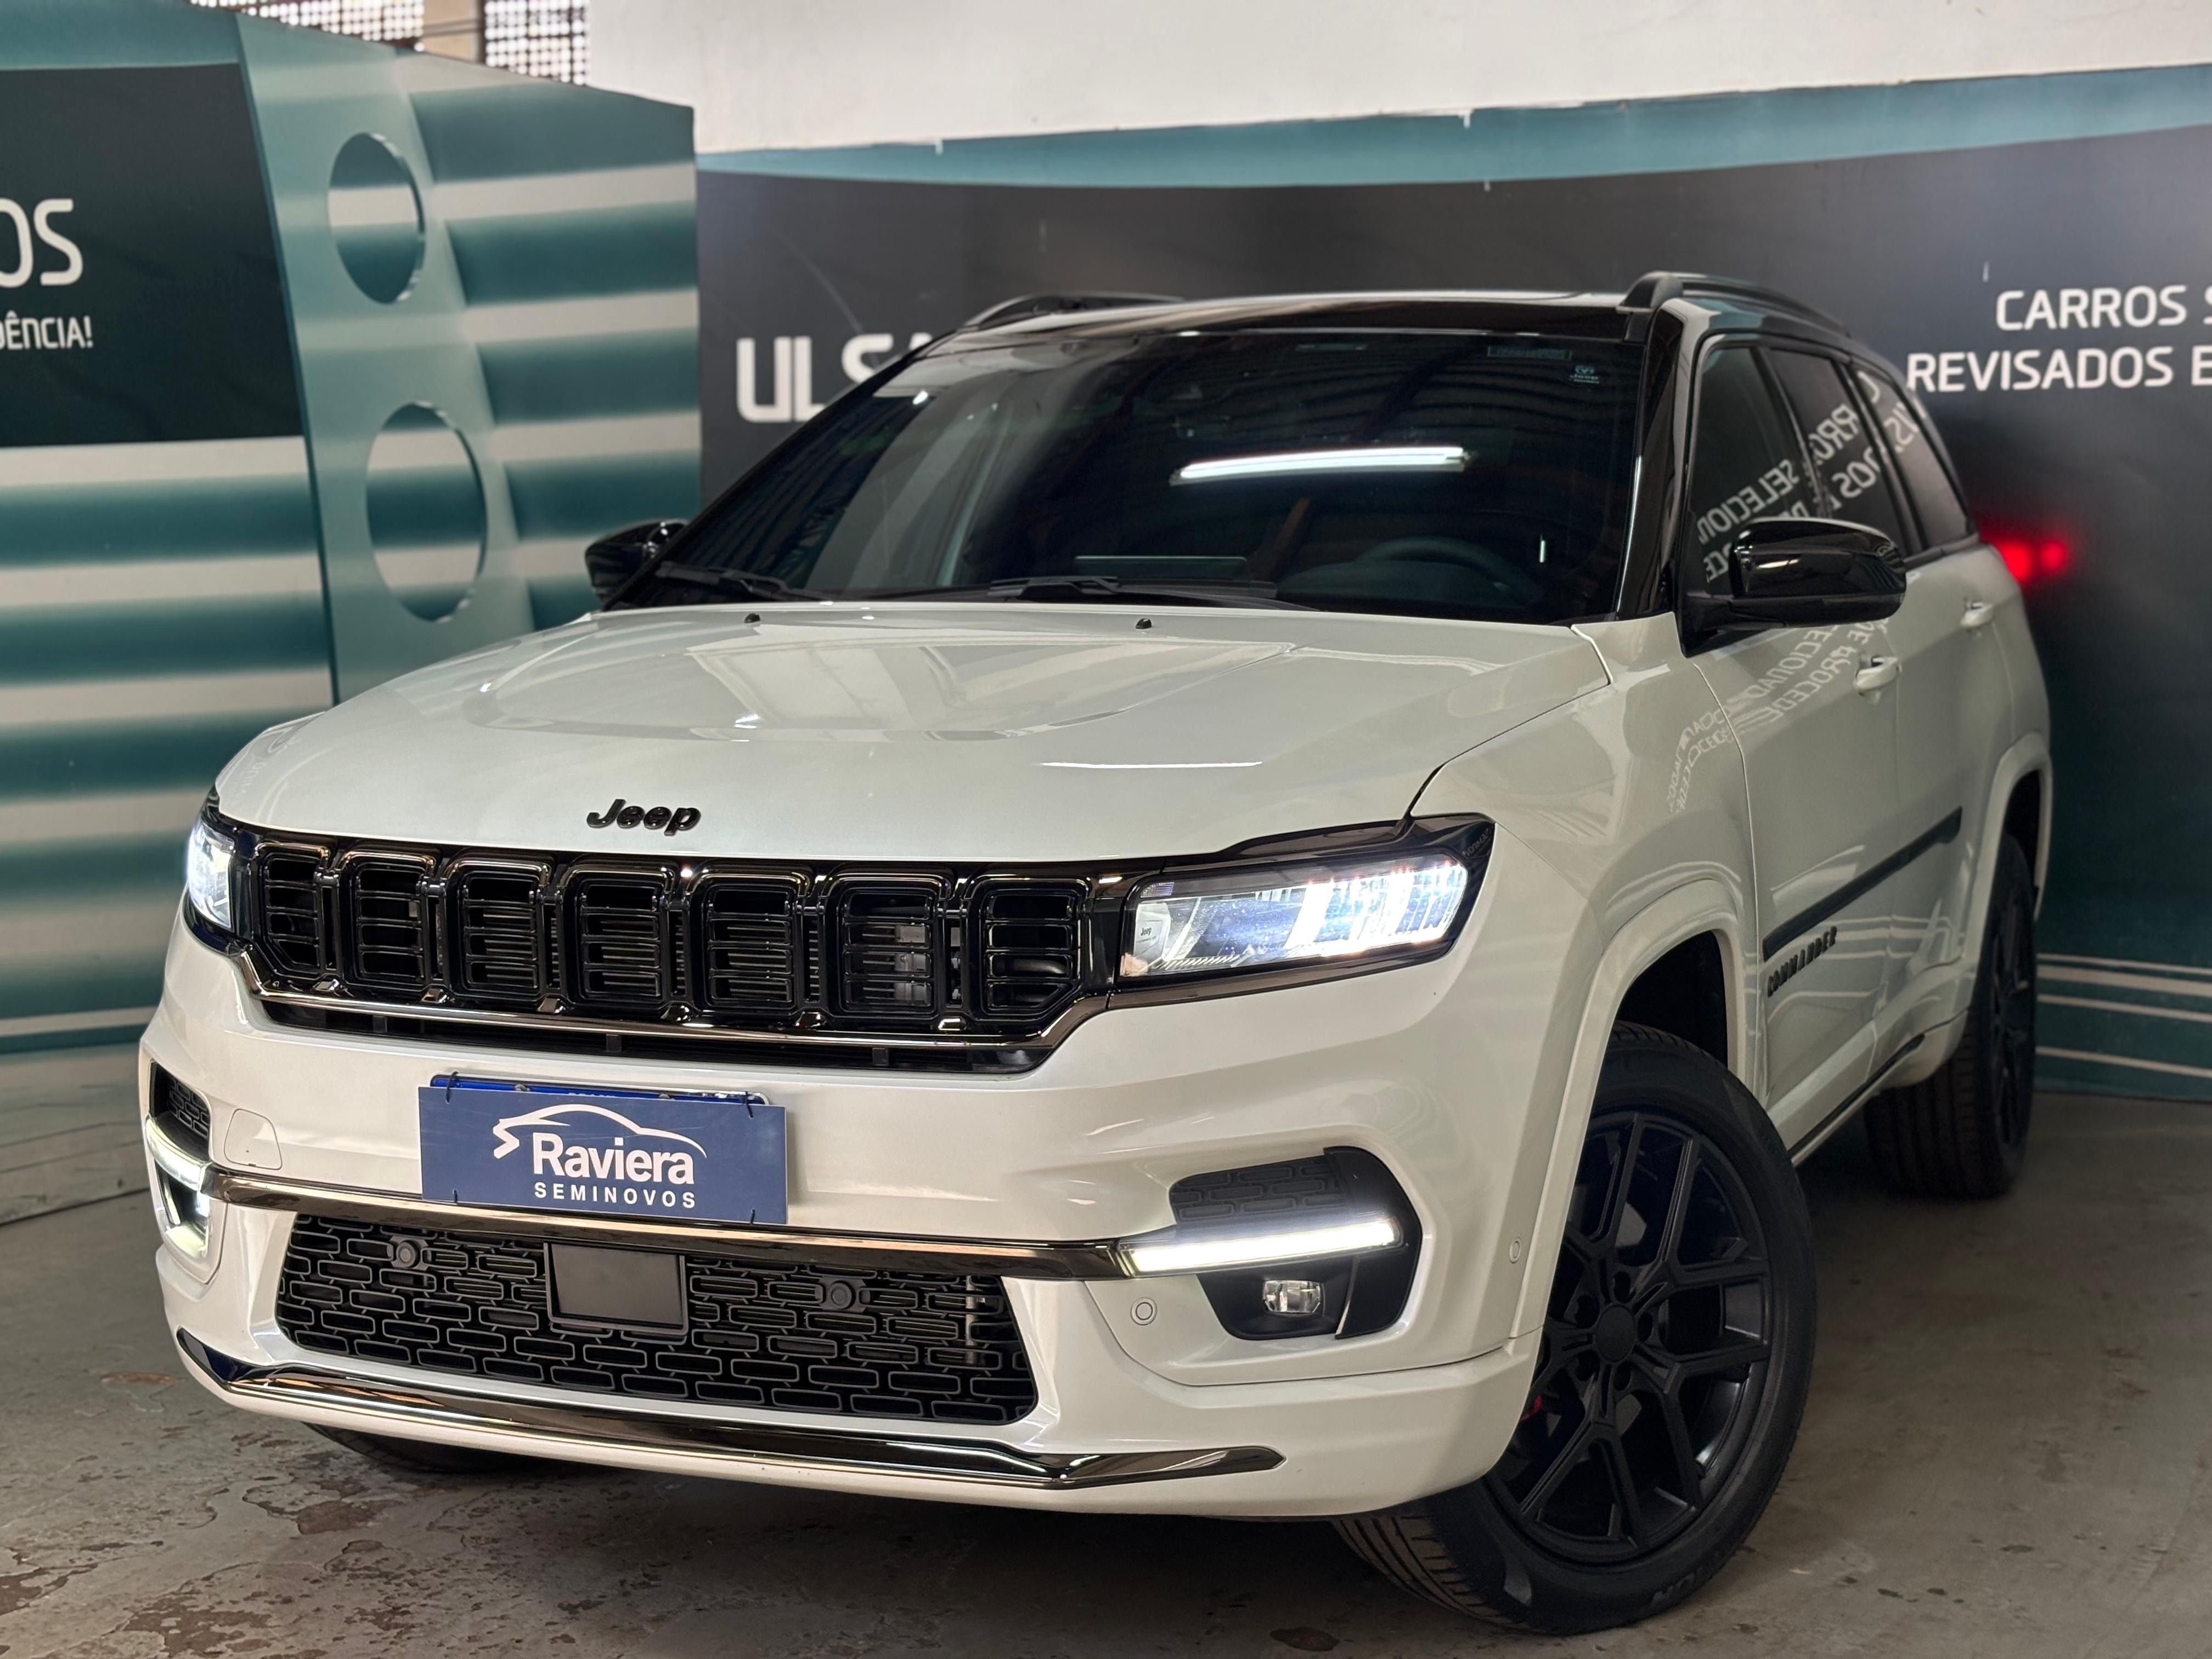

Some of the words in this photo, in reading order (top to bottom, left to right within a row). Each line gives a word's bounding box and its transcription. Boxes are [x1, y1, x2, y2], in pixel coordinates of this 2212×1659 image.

[1996, 285, 2187, 330] CARROS
[1906, 346, 2174, 392] REVISADOS
[586, 799, 701, 836] Jeep
[533, 1132, 695, 1184] Raviera
[534, 1182, 696, 1209] SEMINOVOS
